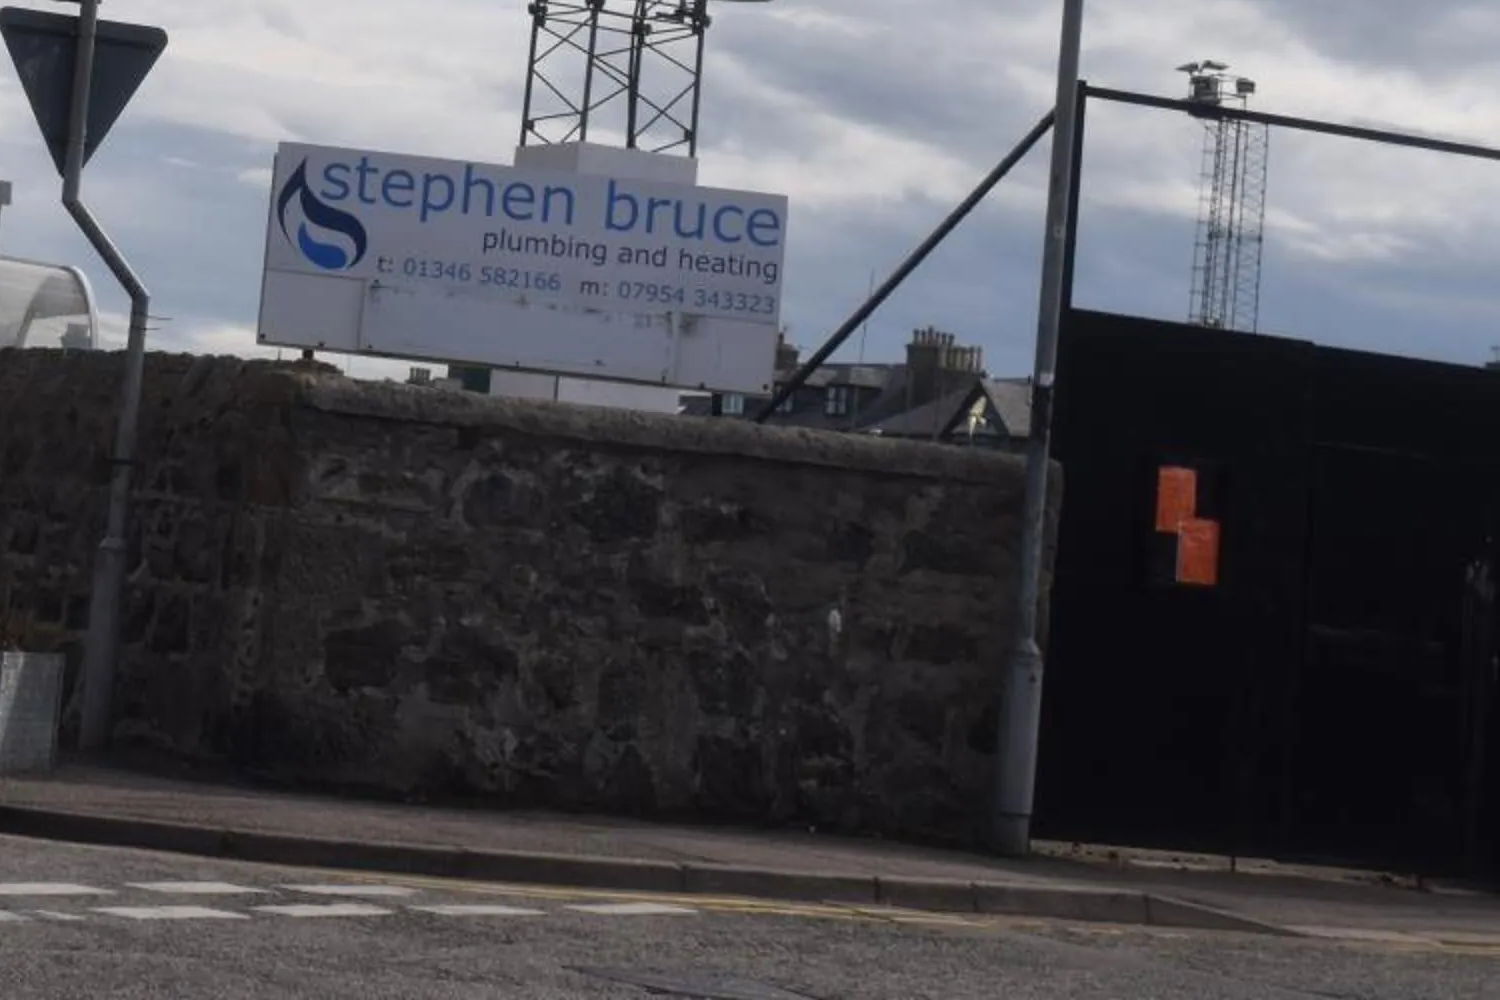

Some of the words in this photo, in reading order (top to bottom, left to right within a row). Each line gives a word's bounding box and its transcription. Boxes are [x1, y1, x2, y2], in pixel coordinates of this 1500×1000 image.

[320, 156, 574, 227] stephen
[605, 179, 782, 247] bruce
[376, 255, 395, 275] t:
[402, 257, 472, 283] 01346
[480, 265, 562, 293] 582166
[579, 277, 609, 298] m:
[616, 279, 685, 305] 07954
[693, 287, 776, 315] 343323
[482, 229, 608, 266] plumbing
[618, 242, 668, 268] and
[679, 241, 779, 283] heating
